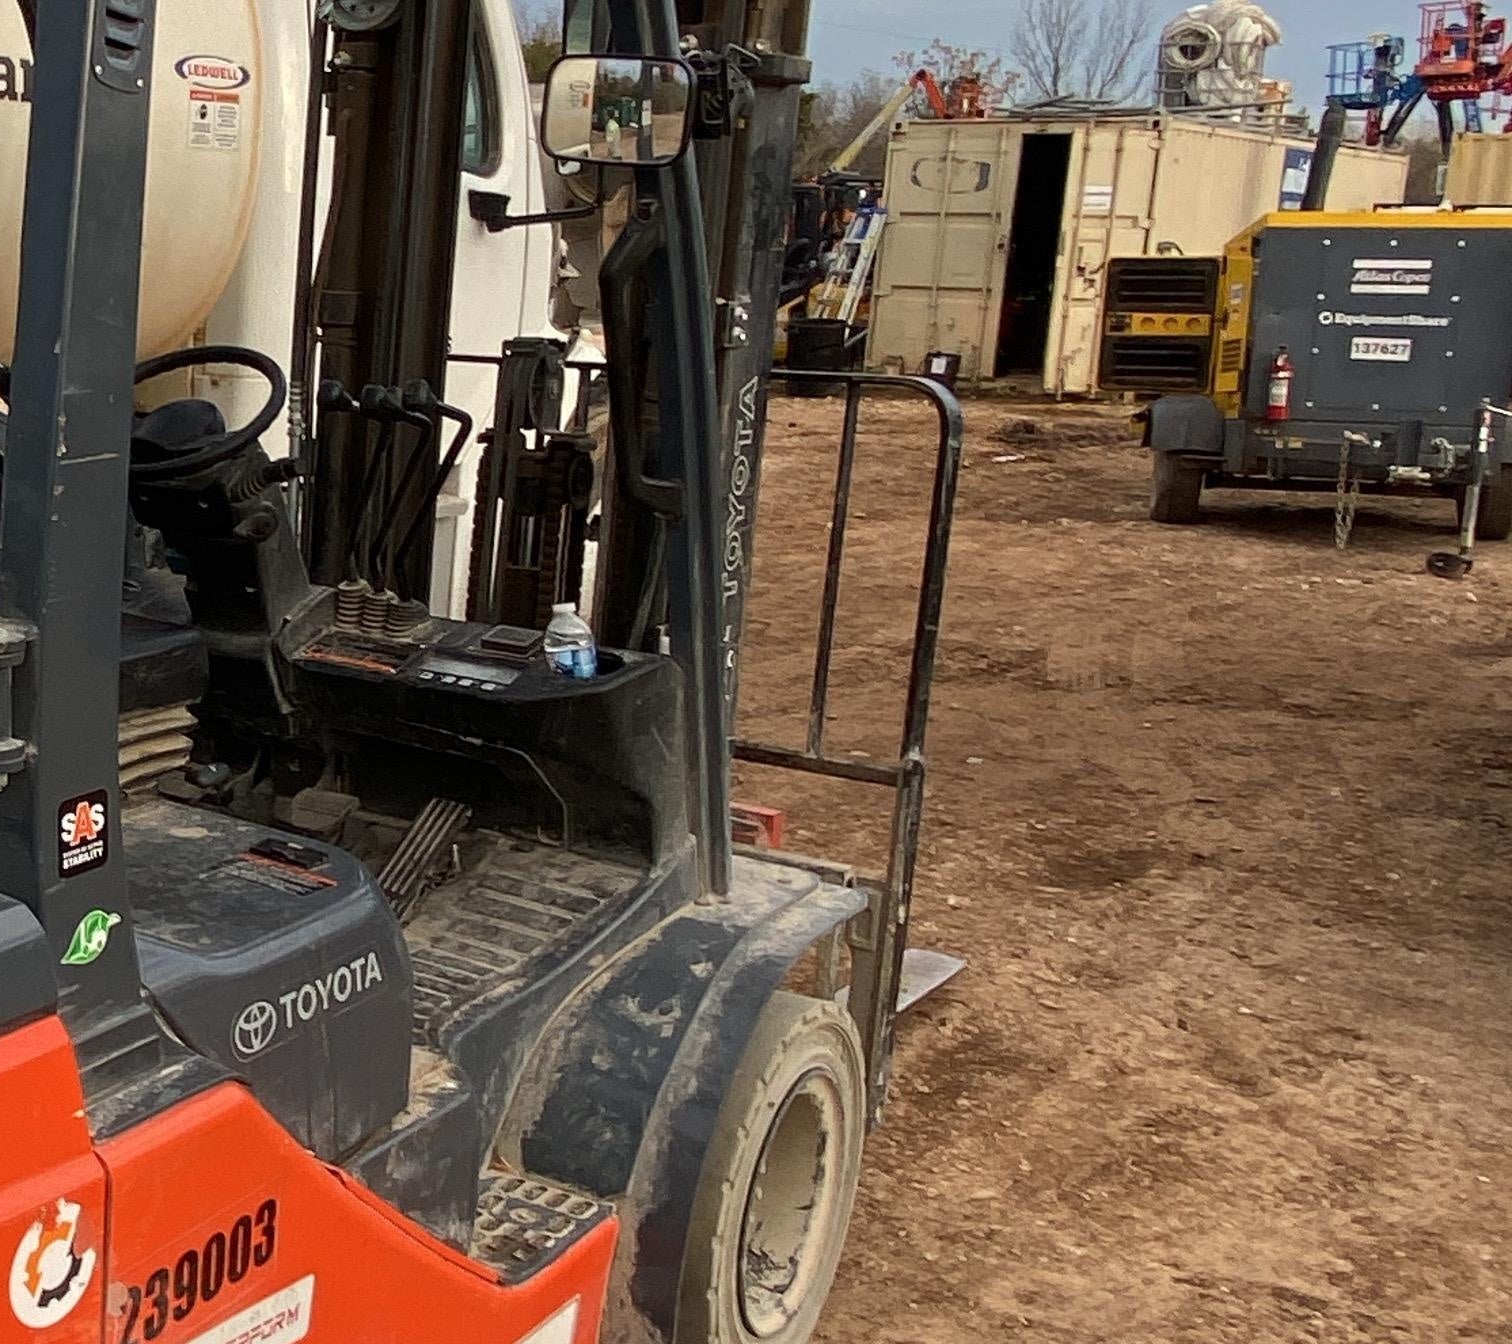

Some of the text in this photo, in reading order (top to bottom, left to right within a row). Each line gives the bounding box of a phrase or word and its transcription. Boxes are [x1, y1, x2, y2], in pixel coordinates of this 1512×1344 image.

[188, 63, 239, 81] LEDWELL
[1353, 342, 1409, 355] 137627
[721, 375, 760, 606] TOYOTA
[60, 800, 105, 847] SAS
[279, 951, 383, 1030] TOYOTA
